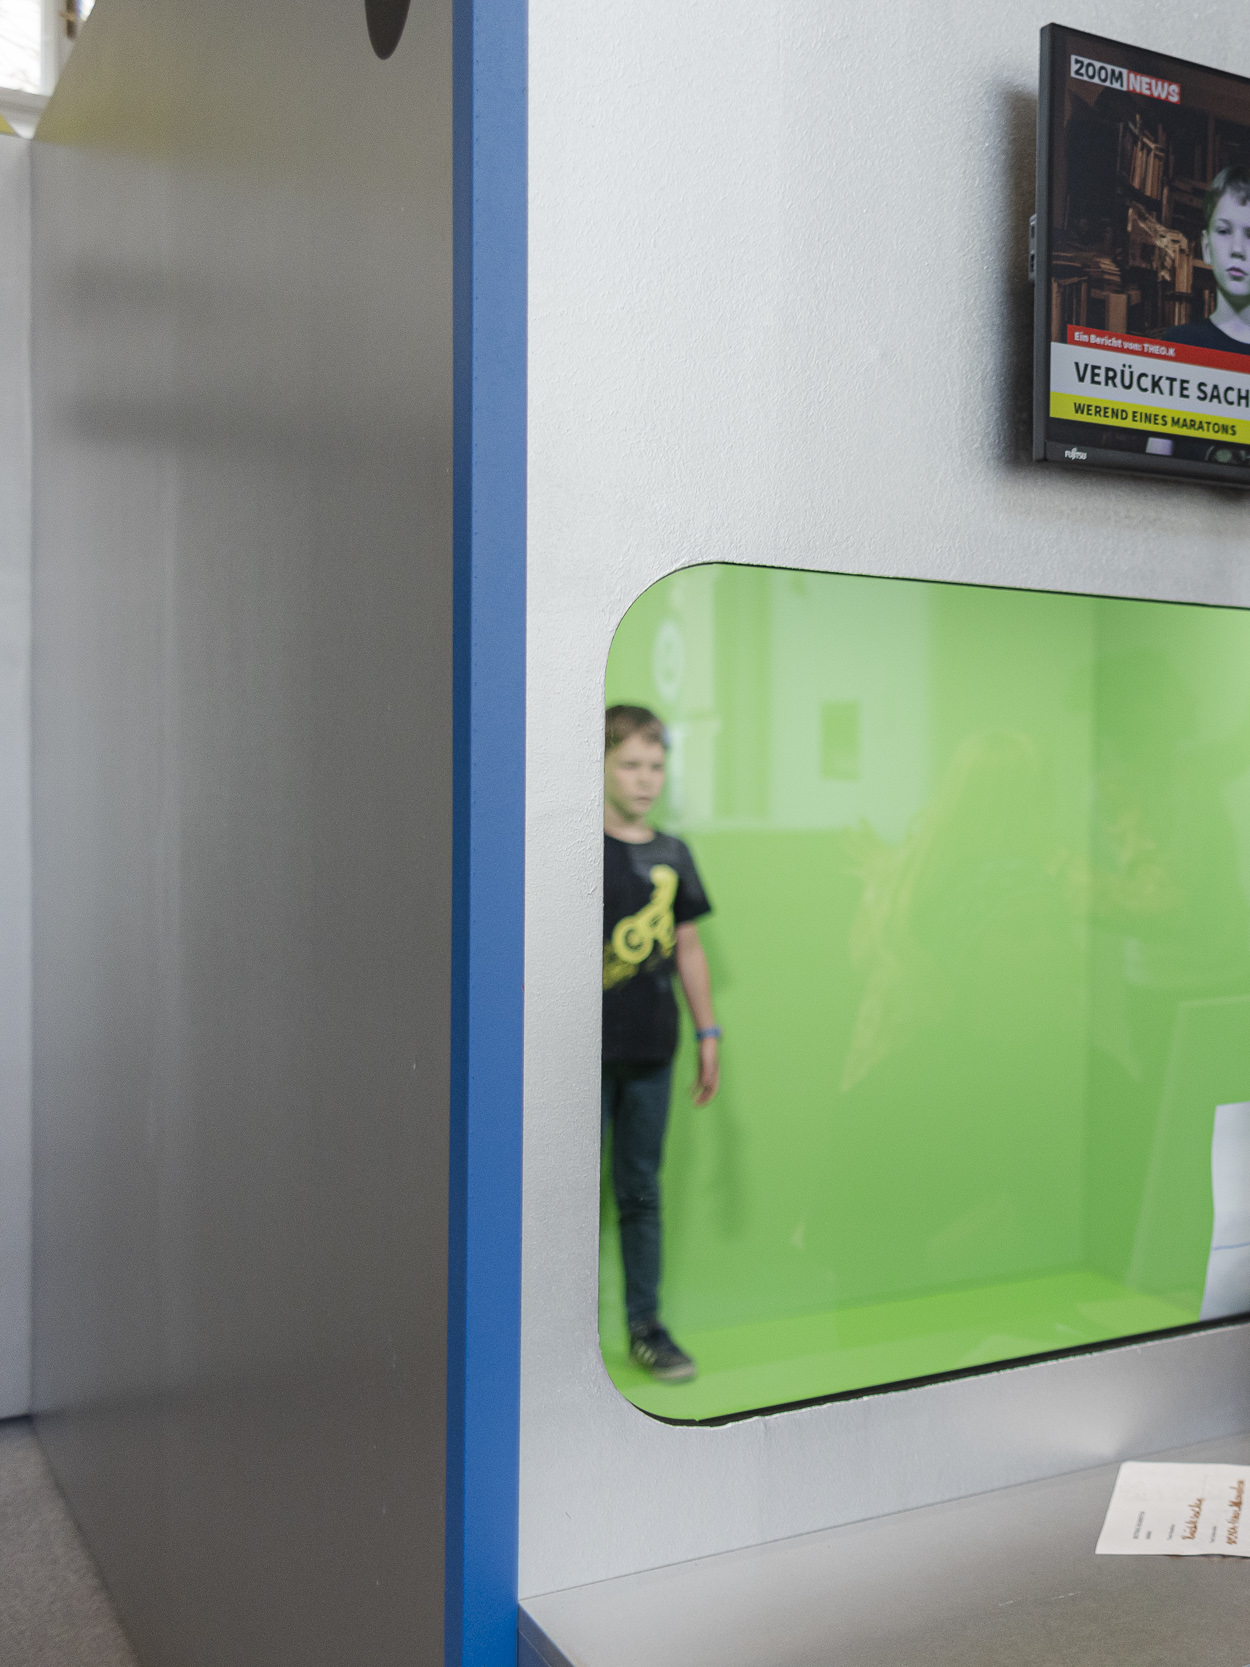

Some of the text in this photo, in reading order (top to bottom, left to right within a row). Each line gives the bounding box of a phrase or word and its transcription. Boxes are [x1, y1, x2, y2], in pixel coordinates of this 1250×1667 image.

[1074, 58, 1179, 102] ZOOM NEWS
[1074, 331, 1089, 343] Ein
[1089, 334, 1123, 349] Bericht
[1074, 361, 1191, 399] VERÜCKTE
[1074, 402, 1237, 436] WEREND EINES MARATONS
